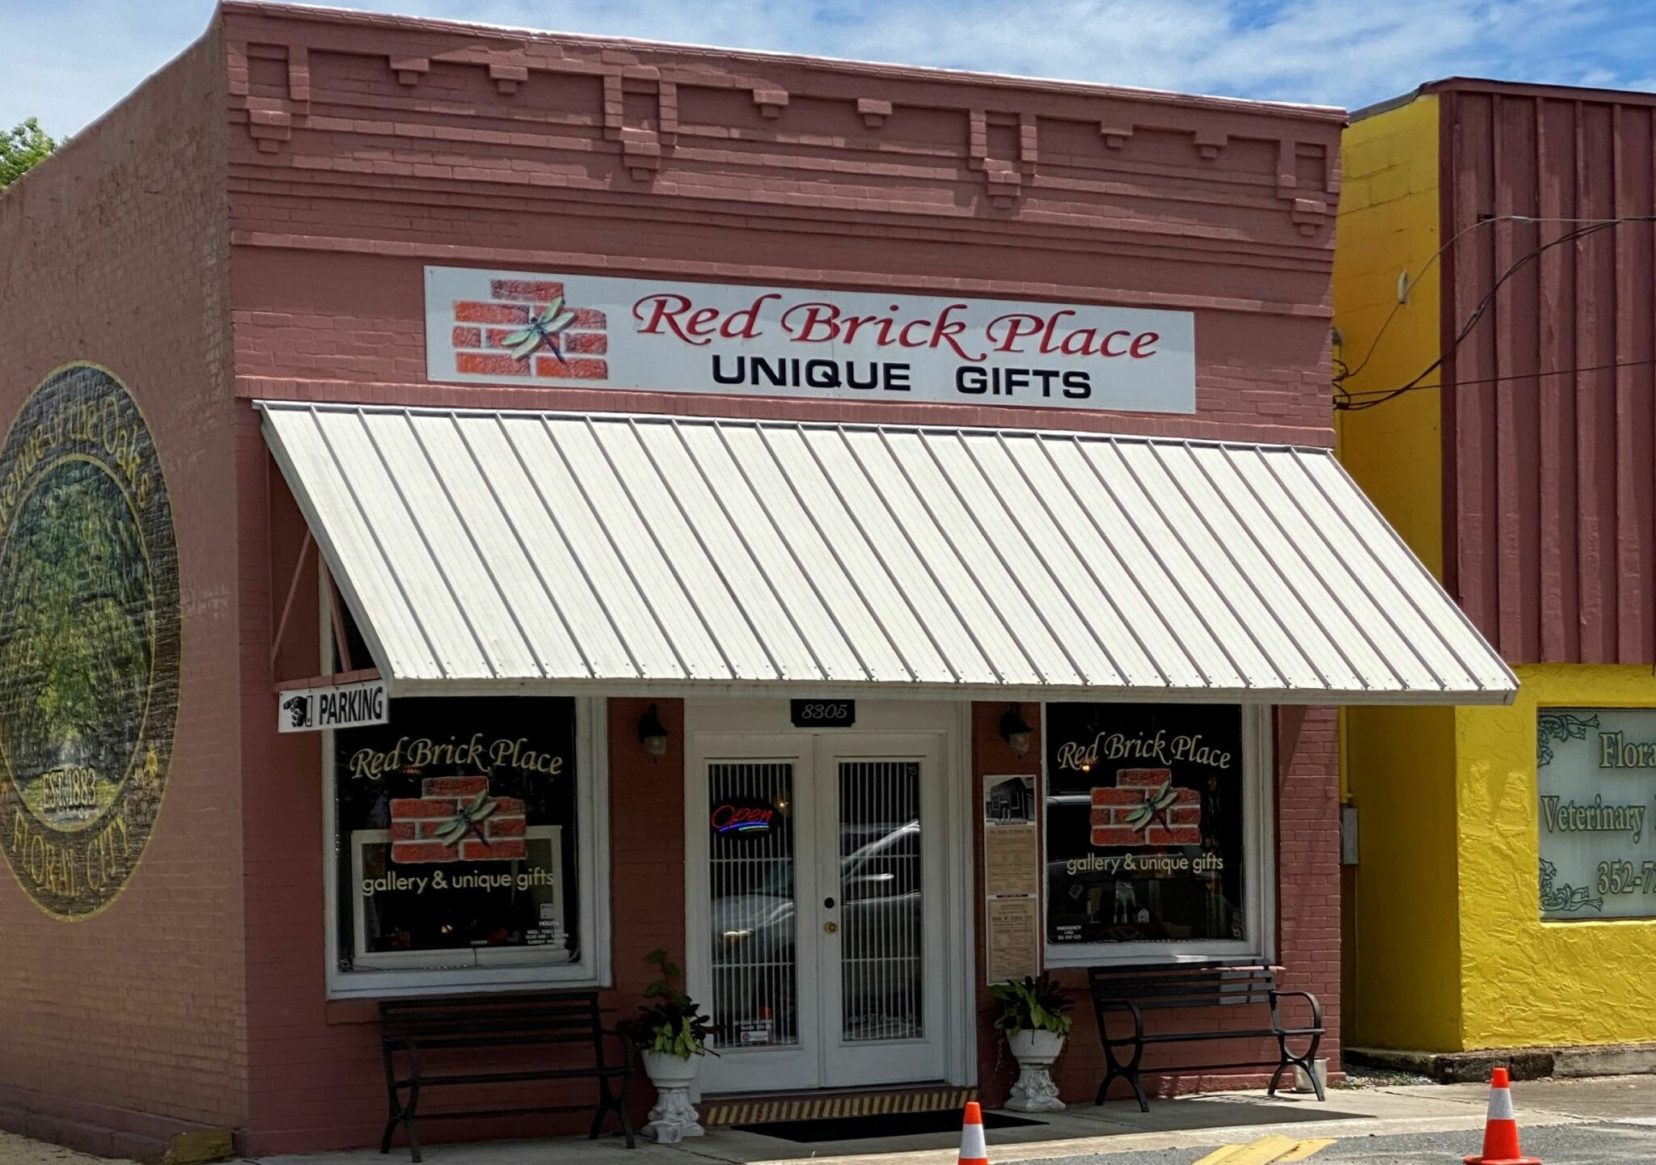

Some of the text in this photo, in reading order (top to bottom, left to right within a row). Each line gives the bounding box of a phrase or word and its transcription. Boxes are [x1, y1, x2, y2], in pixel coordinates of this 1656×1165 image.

[633, 294, 1159, 362] Red Brick Place
[712, 355, 1092, 398] UNIQUE GIFTS
[319, 688, 383, 724] PARKING
[350, 733, 564, 780] Red Brick Place
[1057, 730, 1232, 771] Red Brick Place
[1599, 730, 1656, 769] Flora
[1541, 794, 1646, 844] Veterinary
[361, 867, 554, 896] gallery & unique gifts
[1066, 852, 1224, 875] gallery & unique gifts
